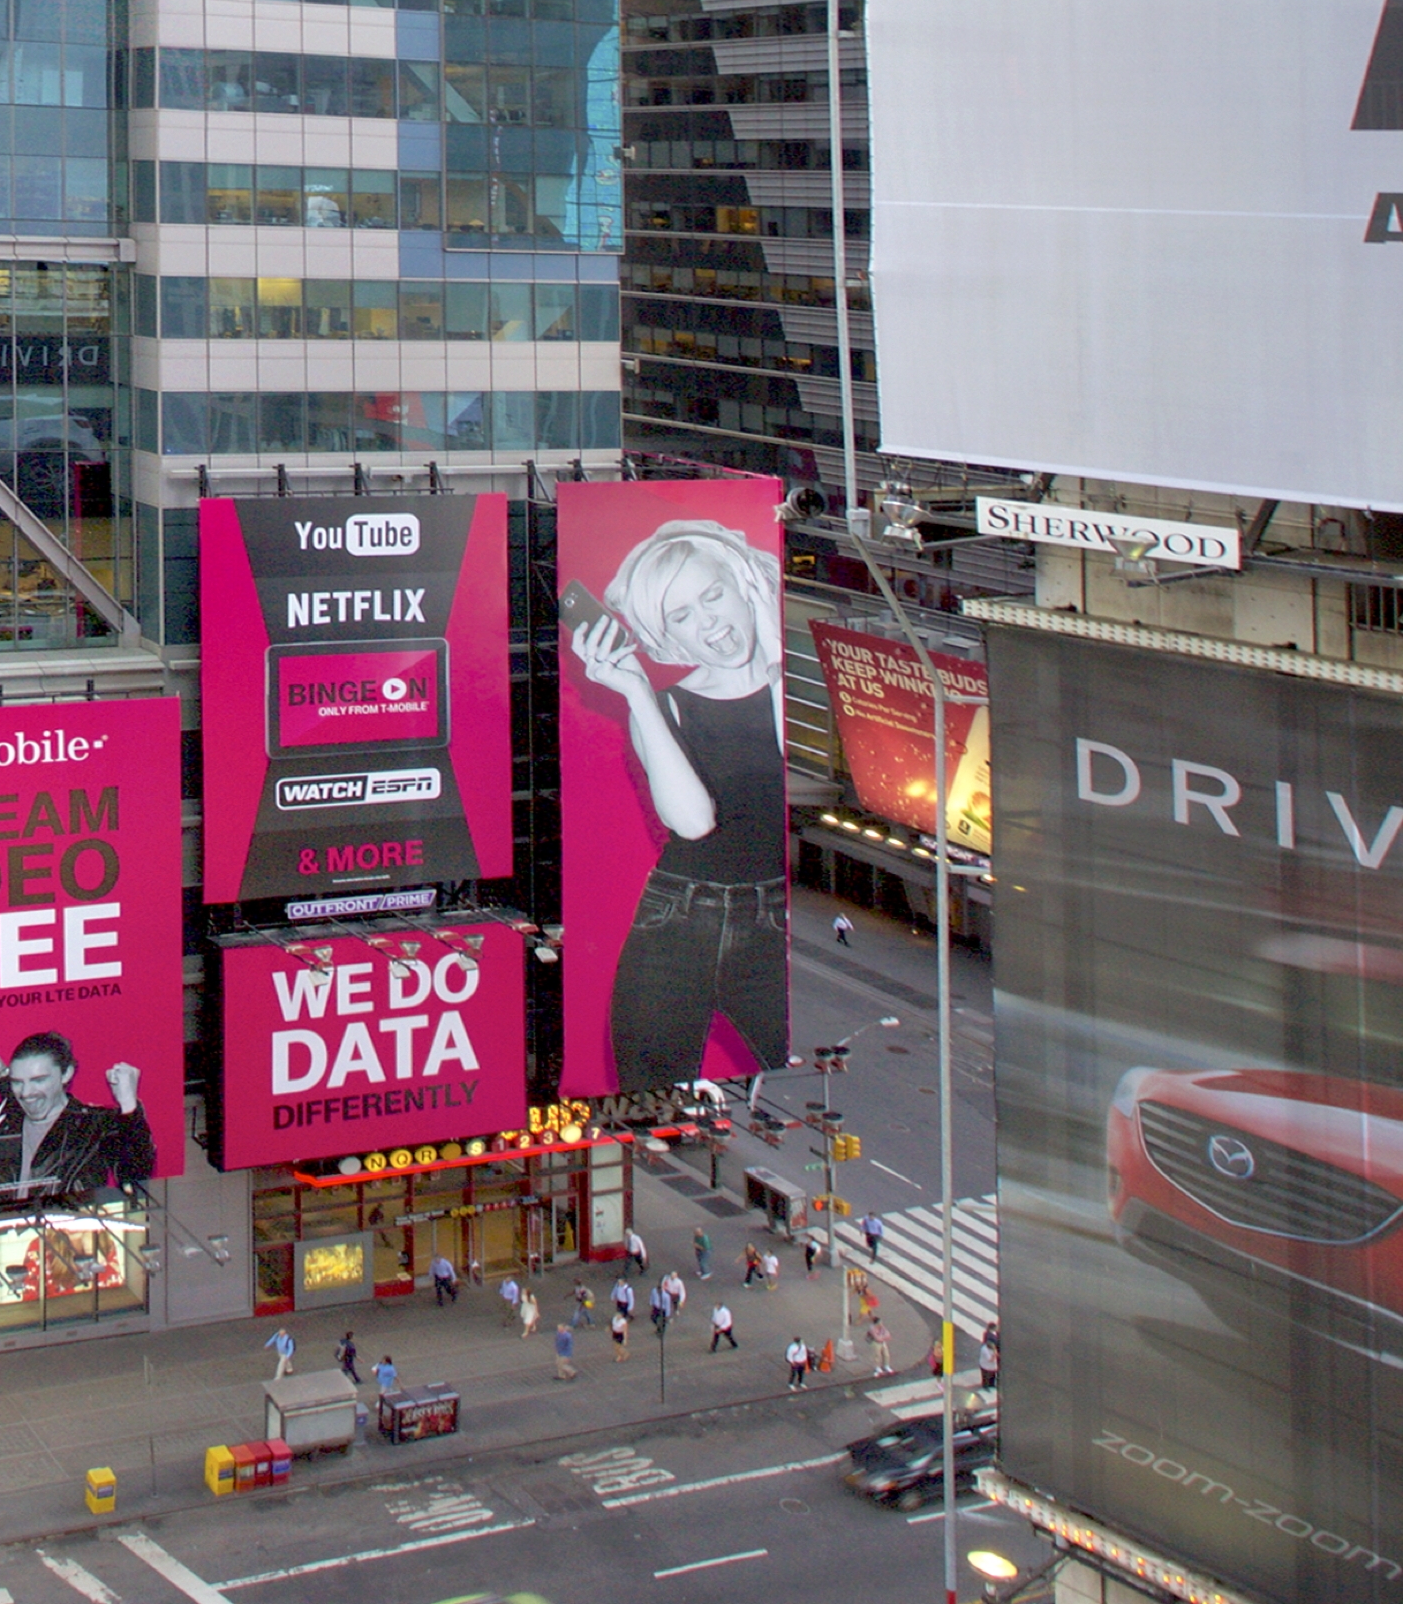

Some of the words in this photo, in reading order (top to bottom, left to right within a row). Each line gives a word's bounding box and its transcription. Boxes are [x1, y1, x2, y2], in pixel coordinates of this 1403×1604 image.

[294, 520, 413, 550] YouTube
[287, 588, 426, 629] NETFLIX
[826, 638, 875, 665] YOUR
[875, 651, 934, 680] TASTE
[938, 669, 988, 696] BUDS
[831, 655, 878, 679] KEEP
[288, 680, 377, 706] BINGE
[837, 673, 857, 691] AT
[860, 681, 885, 699] US
[318, 705, 346, 717] ONLY
[348, 704, 379, 716] FROM
[380, 701, 429, 714] T-MOBILE
[283, 780, 363, 802] WATCH
[371, 776, 433, 795] ESPN
[1076, 737, 1403, 870] DRIV
[297, 848, 320, 876] &
[326, 839, 425, 873] MORE
[387, 891, 431, 907] PRIME
[45, 987, 75, 1004] LTE
[78, 982, 122, 1001] DATA
[271, 962, 375, 1022] WE
[388, 952, 480, 1010] DO
[271, 1010, 480, 1096] DATA
[273, 1079, 479, 1131] DIFFERENTLY
[1092, 1429, 1403, 1580] zoom-zoom
